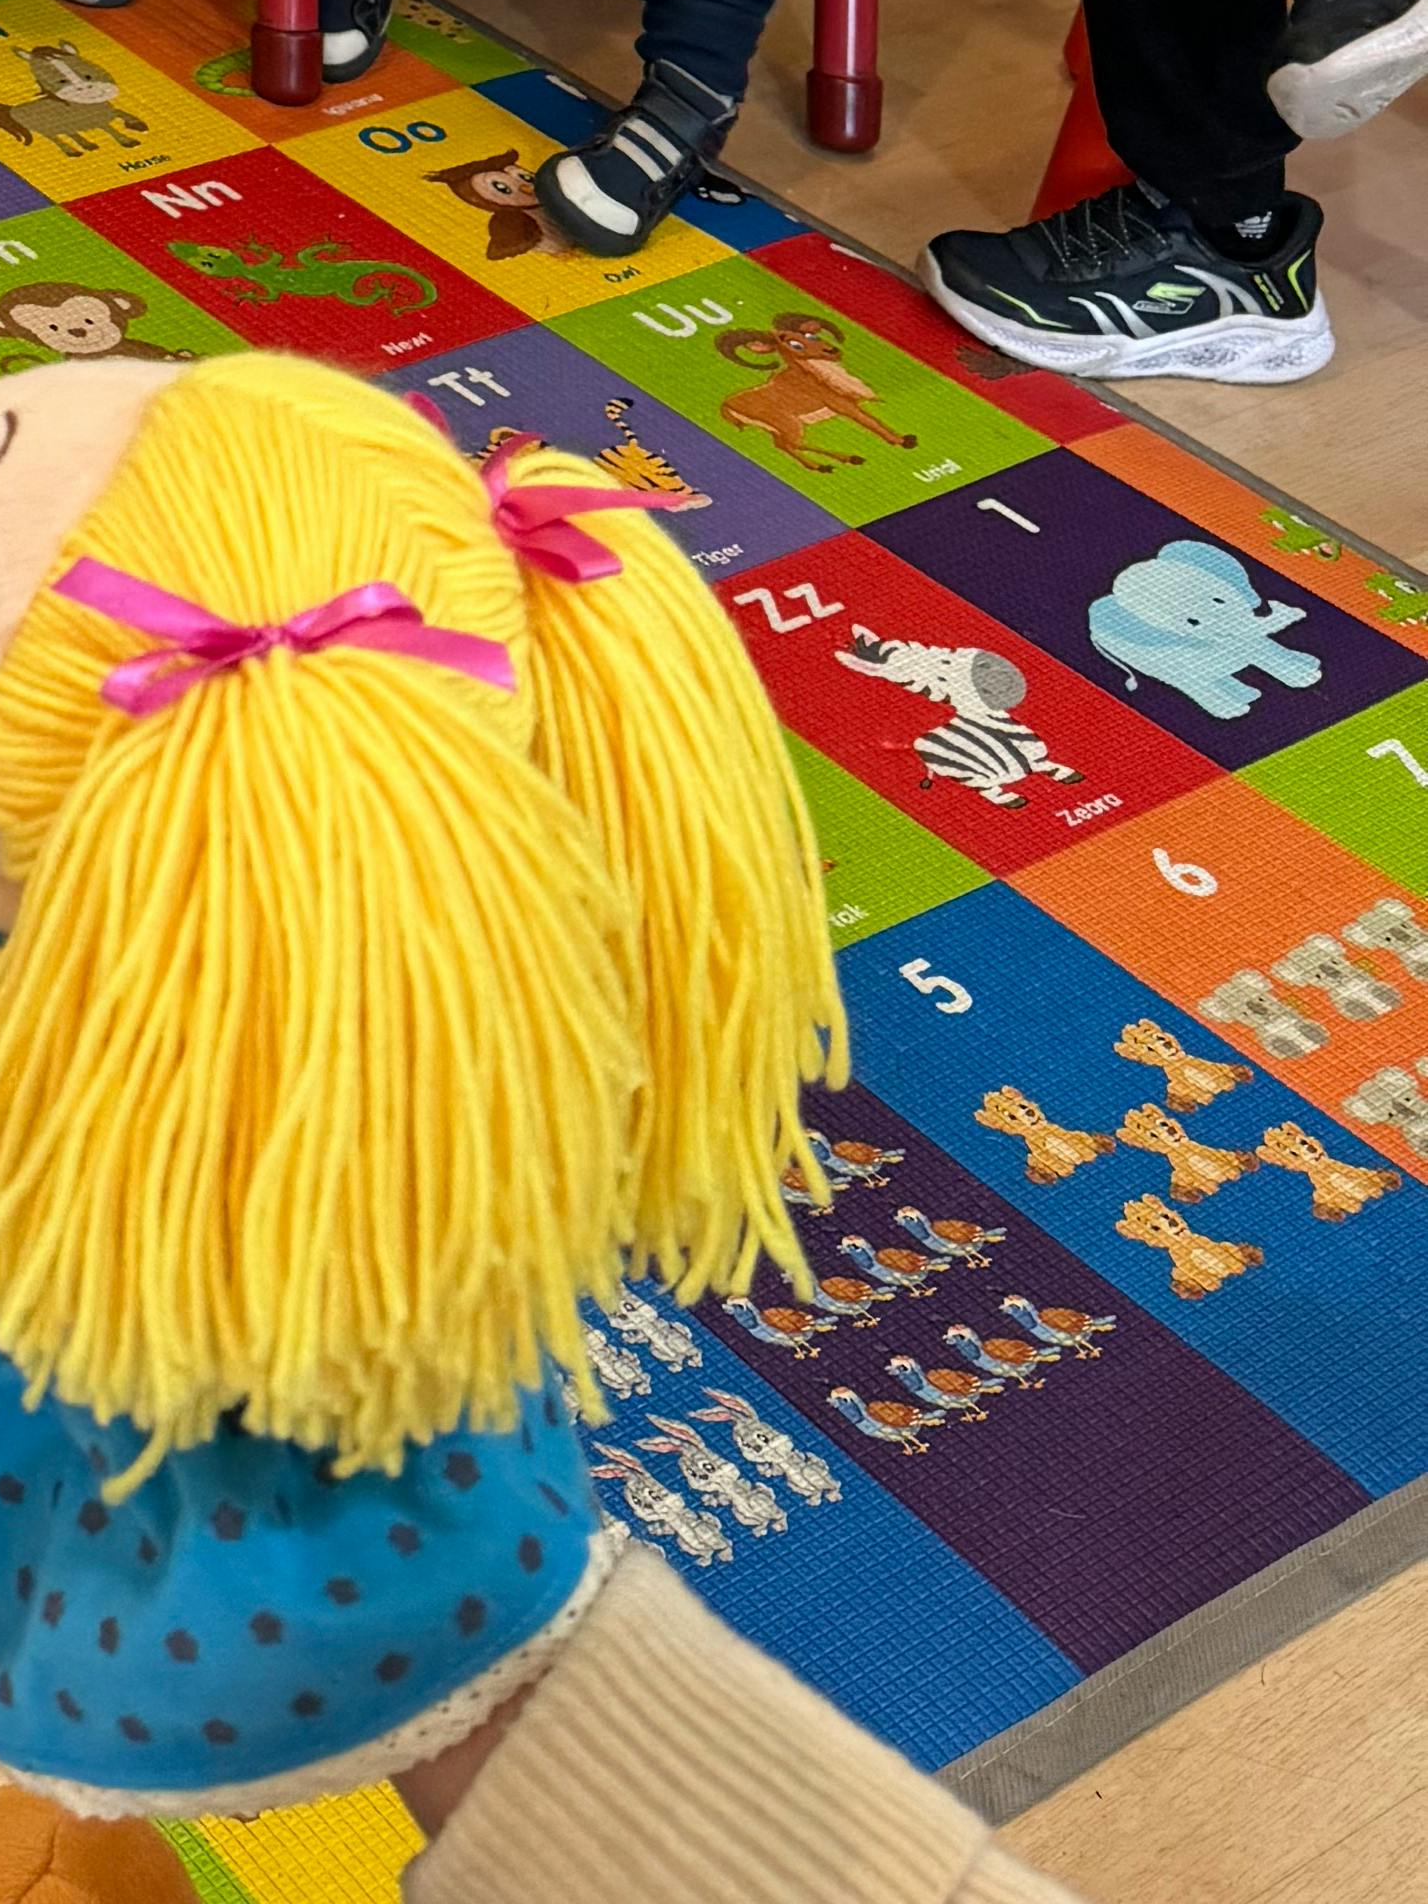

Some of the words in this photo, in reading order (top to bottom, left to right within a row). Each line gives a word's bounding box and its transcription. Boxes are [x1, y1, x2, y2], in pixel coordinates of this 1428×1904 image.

[358, 119, 447, 156] Oo
[118, 152, 173, 174] Horse
[142, 175, 243, 220] Nn
[602, 265, 642, 286] Owl
[632, 293, 735, 340] Uu
[380, 331, 434, 358] Newt
[428, 365, 512, 409] Tt
[911, 458, 963, 485] Urial
[976, 497, 1041, 534] 1
[691, 542, 745, 569] Tiger
[732, 582, 846, 634] Zz
[1364, 738, 1428, 788] 7
[1055, 792, 1124, 829] Zebra
[1151, 847, 1219, 897] 6
[898, 957, 974, 1015] 5
